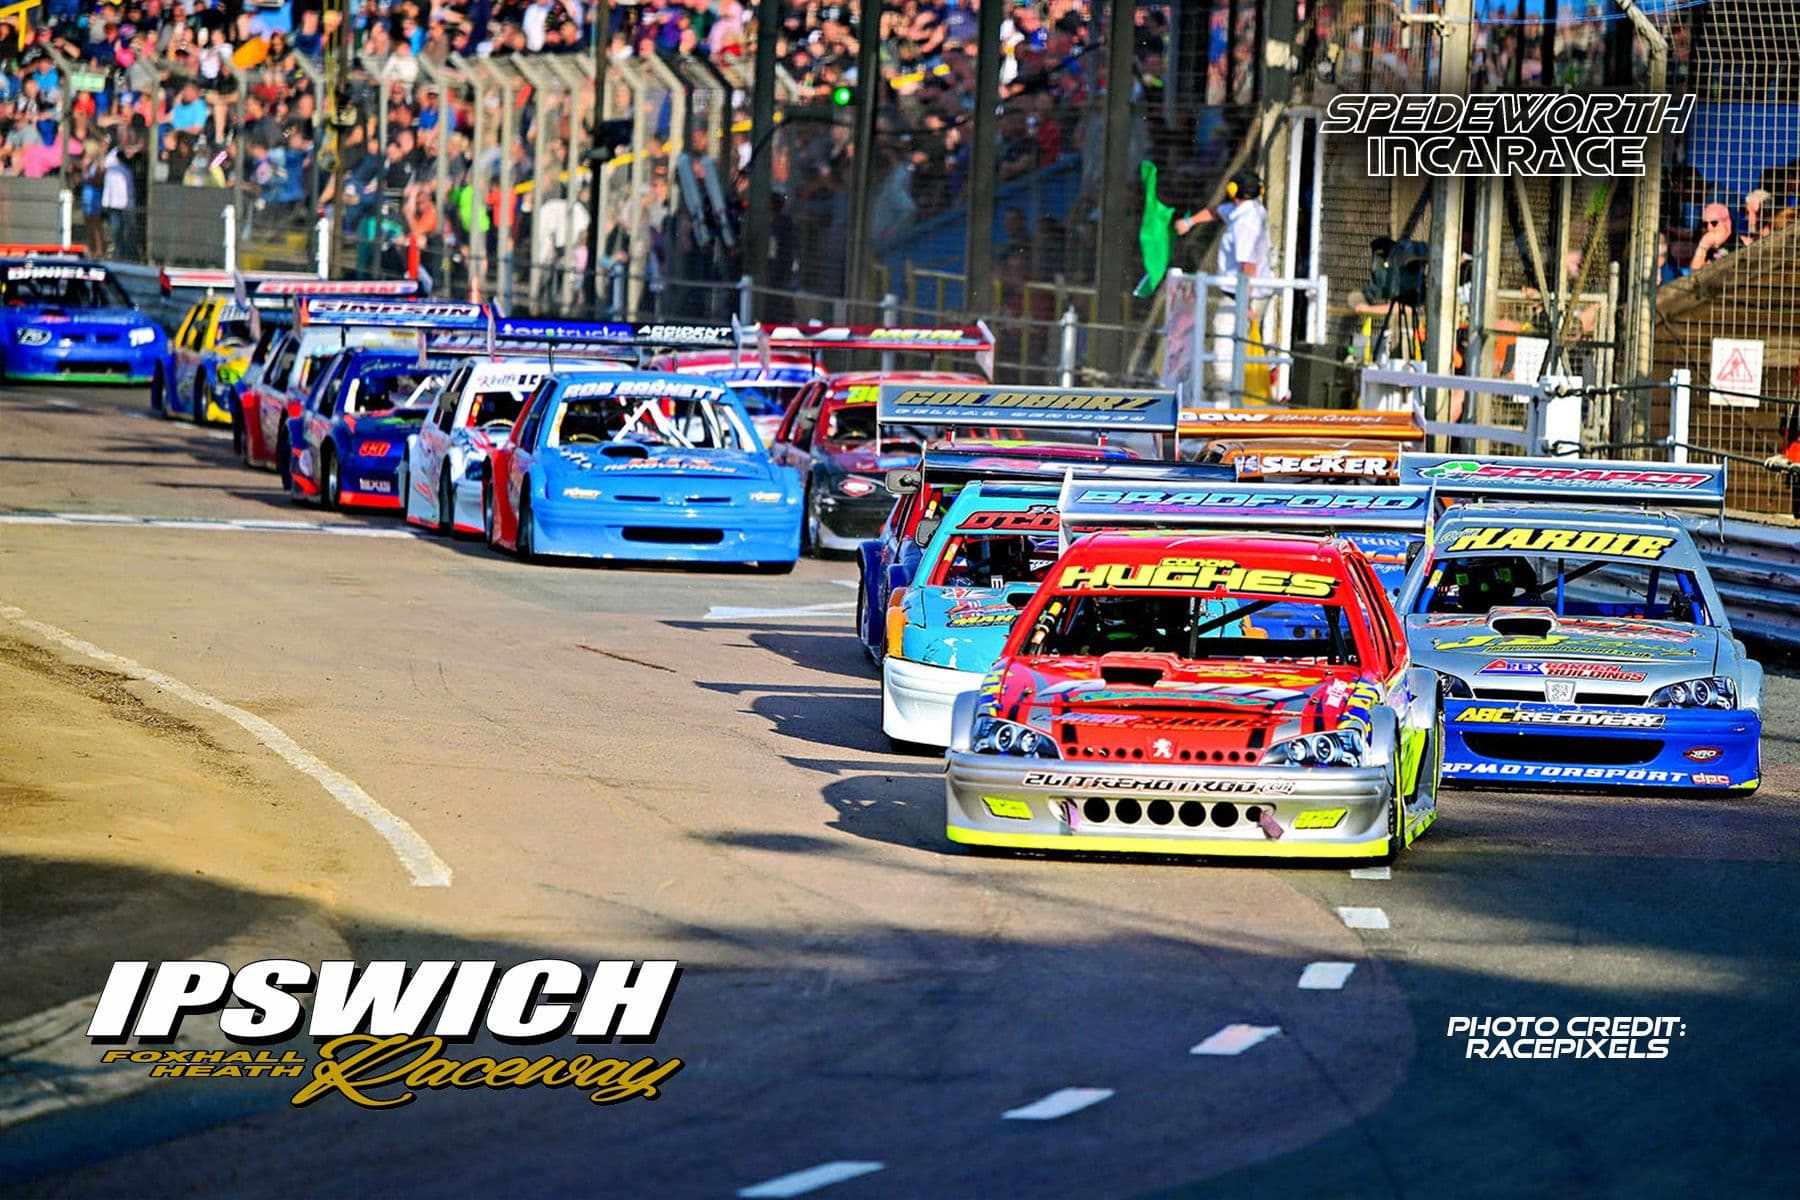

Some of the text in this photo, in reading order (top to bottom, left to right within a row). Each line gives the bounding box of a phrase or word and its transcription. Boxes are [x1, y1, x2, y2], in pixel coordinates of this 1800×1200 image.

[8, 266, 106, 281] DANIELS
[314, 302, 473, 316] SIMPSON
[563, 380, 727, 401] ROB BARNETT
[1259, 456, 1388, 476] SECKER
[1475, 466, 1710, 486] SCRAPCO
[1077, 490, 1421, 510] BRADFORD
[1446, 527, 1675, 559] HARDIE
[1057, 564, 1338, 598] HUGHES
